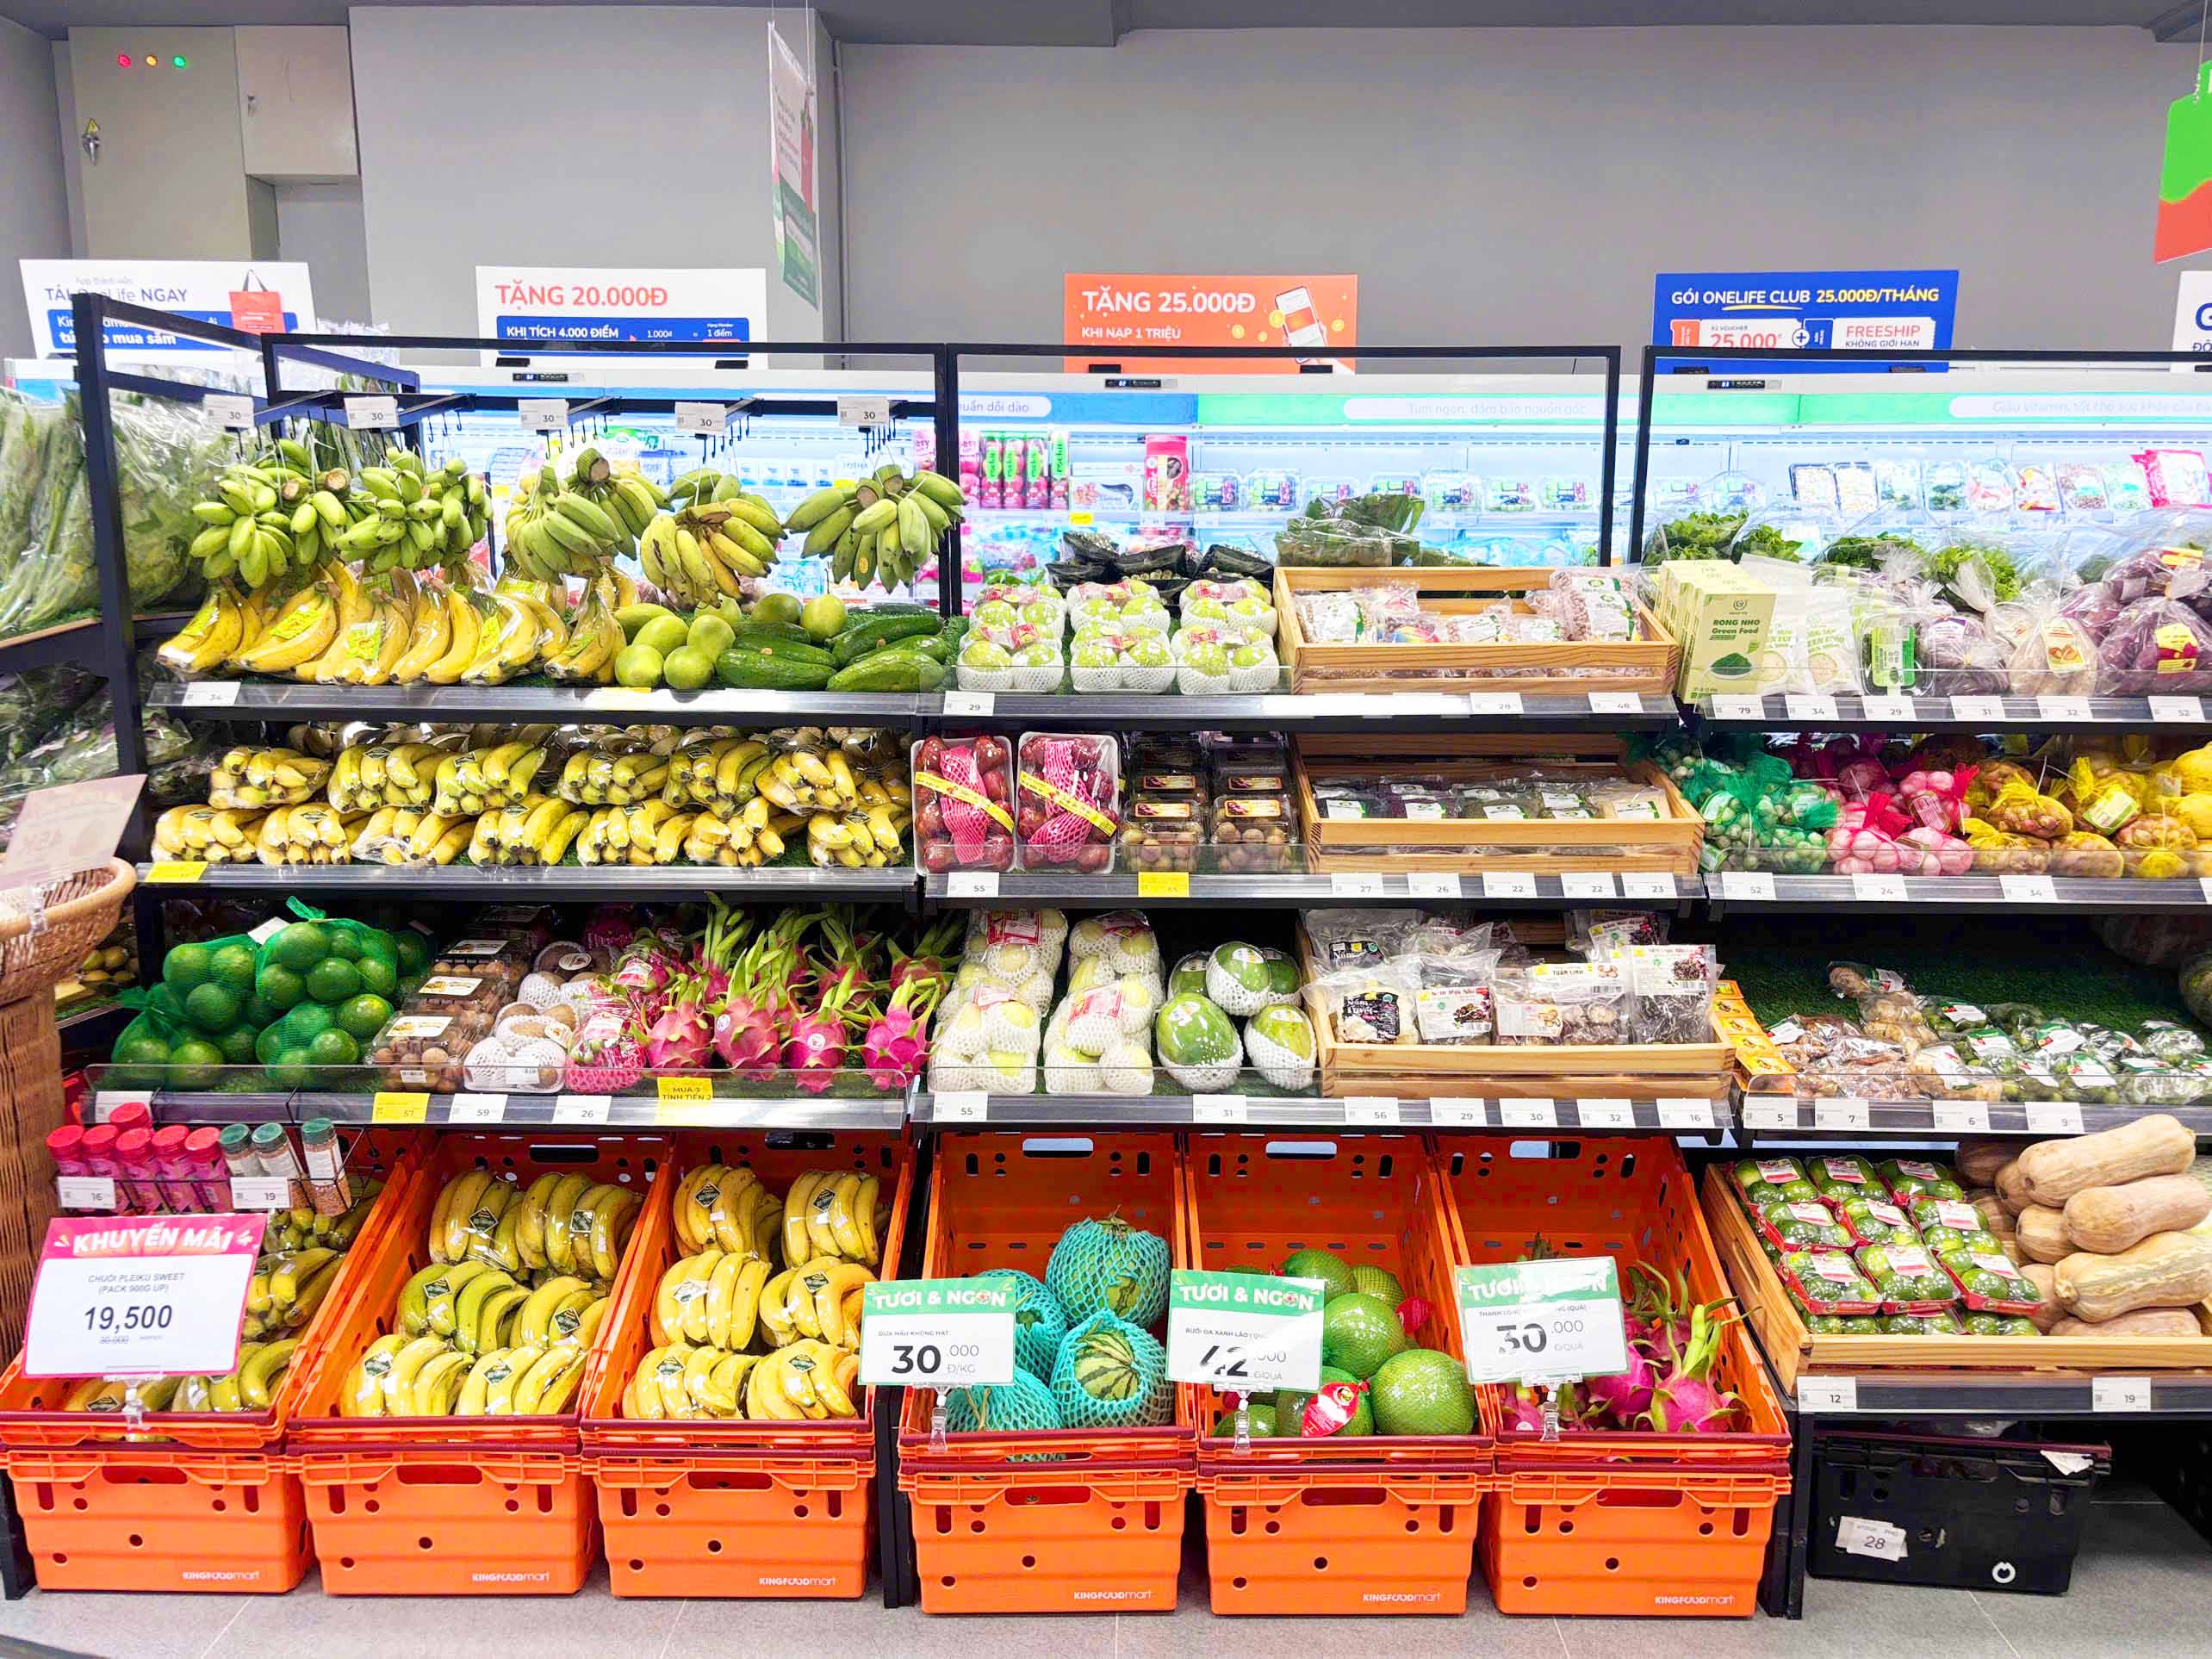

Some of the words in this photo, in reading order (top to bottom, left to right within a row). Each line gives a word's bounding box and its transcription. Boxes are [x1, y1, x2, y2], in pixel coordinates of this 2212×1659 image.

[141, 289, 188, 302] NGAY
[495, 279, 564, 310] TẶNG
[572, 286, 668, 307] 20.000Đ
[1671, 289, 1699, 304] GÓI
[1703, 290, 1767, 305] ONELIFE
[1769, 290, 1811, 304] CLUB
[1816, 285, 1939, 303] 25.000Đ/THÁNG
[1081, 285, 1151, 317] TẶNG
[1158, 291, 1256, 314] 25.000Đ
[529, 324, 556, 338] TÍCH
[558, 327, 588, 339] 4.000
[589, 325, 618, 339] ĐIỂM
[1081, 326, 1103, 339] KHI
[1106, 326, 1132, 341] NẠP
[1135, 327, 1142, 339] 1
[1145, 325, 1181, 341] TRIỆU
[1846, 325, 1921, 338] FREESHIP
[113, 334, 143, 345] mua
[228, 412, 240, 420] 30
[863, 411, 876, 419] 30
[699, 419, 712, 427] 30
[972, 884, 986, 892] 55
[1359, 885, 1372, 893] 27
[1512, 885, 1525, 893] 22
[1591, 885, 1604, 893] 22
[1651, 885, 1664, 893] 23
[1749, 885, 1763, 895] 52
[476, 1108, 490, 1117] 59
[581, 1109, 594, 1118] 26
[960, 1107, 973, 1115] 55
[1222, 1109, 1233, 1117] 31
[1460, 1112, 1473, 1121] 29
[1530, 1112, 1544, 1122] 30
[1608, 1113, 1622, 1122] 32
[1690, 1113, 1701, 1122] 16
[1777, 1114, 1784, 1122] 5
[1968, 1116, 1976, 1125] 6
[90, 1192, 103, 1202] 16
[264, 1192, 276, 1202] 19
[72, 1221, 179, 1254] KHUYẾN
[181, 1226, 234, 1250] MÃI
[118, 1274, 152, 1283] PLEIKU
[153, 1272, 185, 1282] SWEET
[98, 1285, 127, 1294] (PACK
[153, 1284, 169, 1294] UP)
[1178, 1282, 1229, 1302] TƯƠI
[1233, 1286, 1248, 1302] &
[872, 1289, 922, 1310] TƯƠI
[927, 1290, 941, 1305] &
[83, 1304, 173, 1333] 19,500
[1495, 1322, 1548, 1354] 30
[891, 1345, 941, 1374] 30
[1830, 1394, 1842, 1404] 12
[2124, 1394, 2136, 1404] 19
[1863, 1536, 1886, 1550] 28
